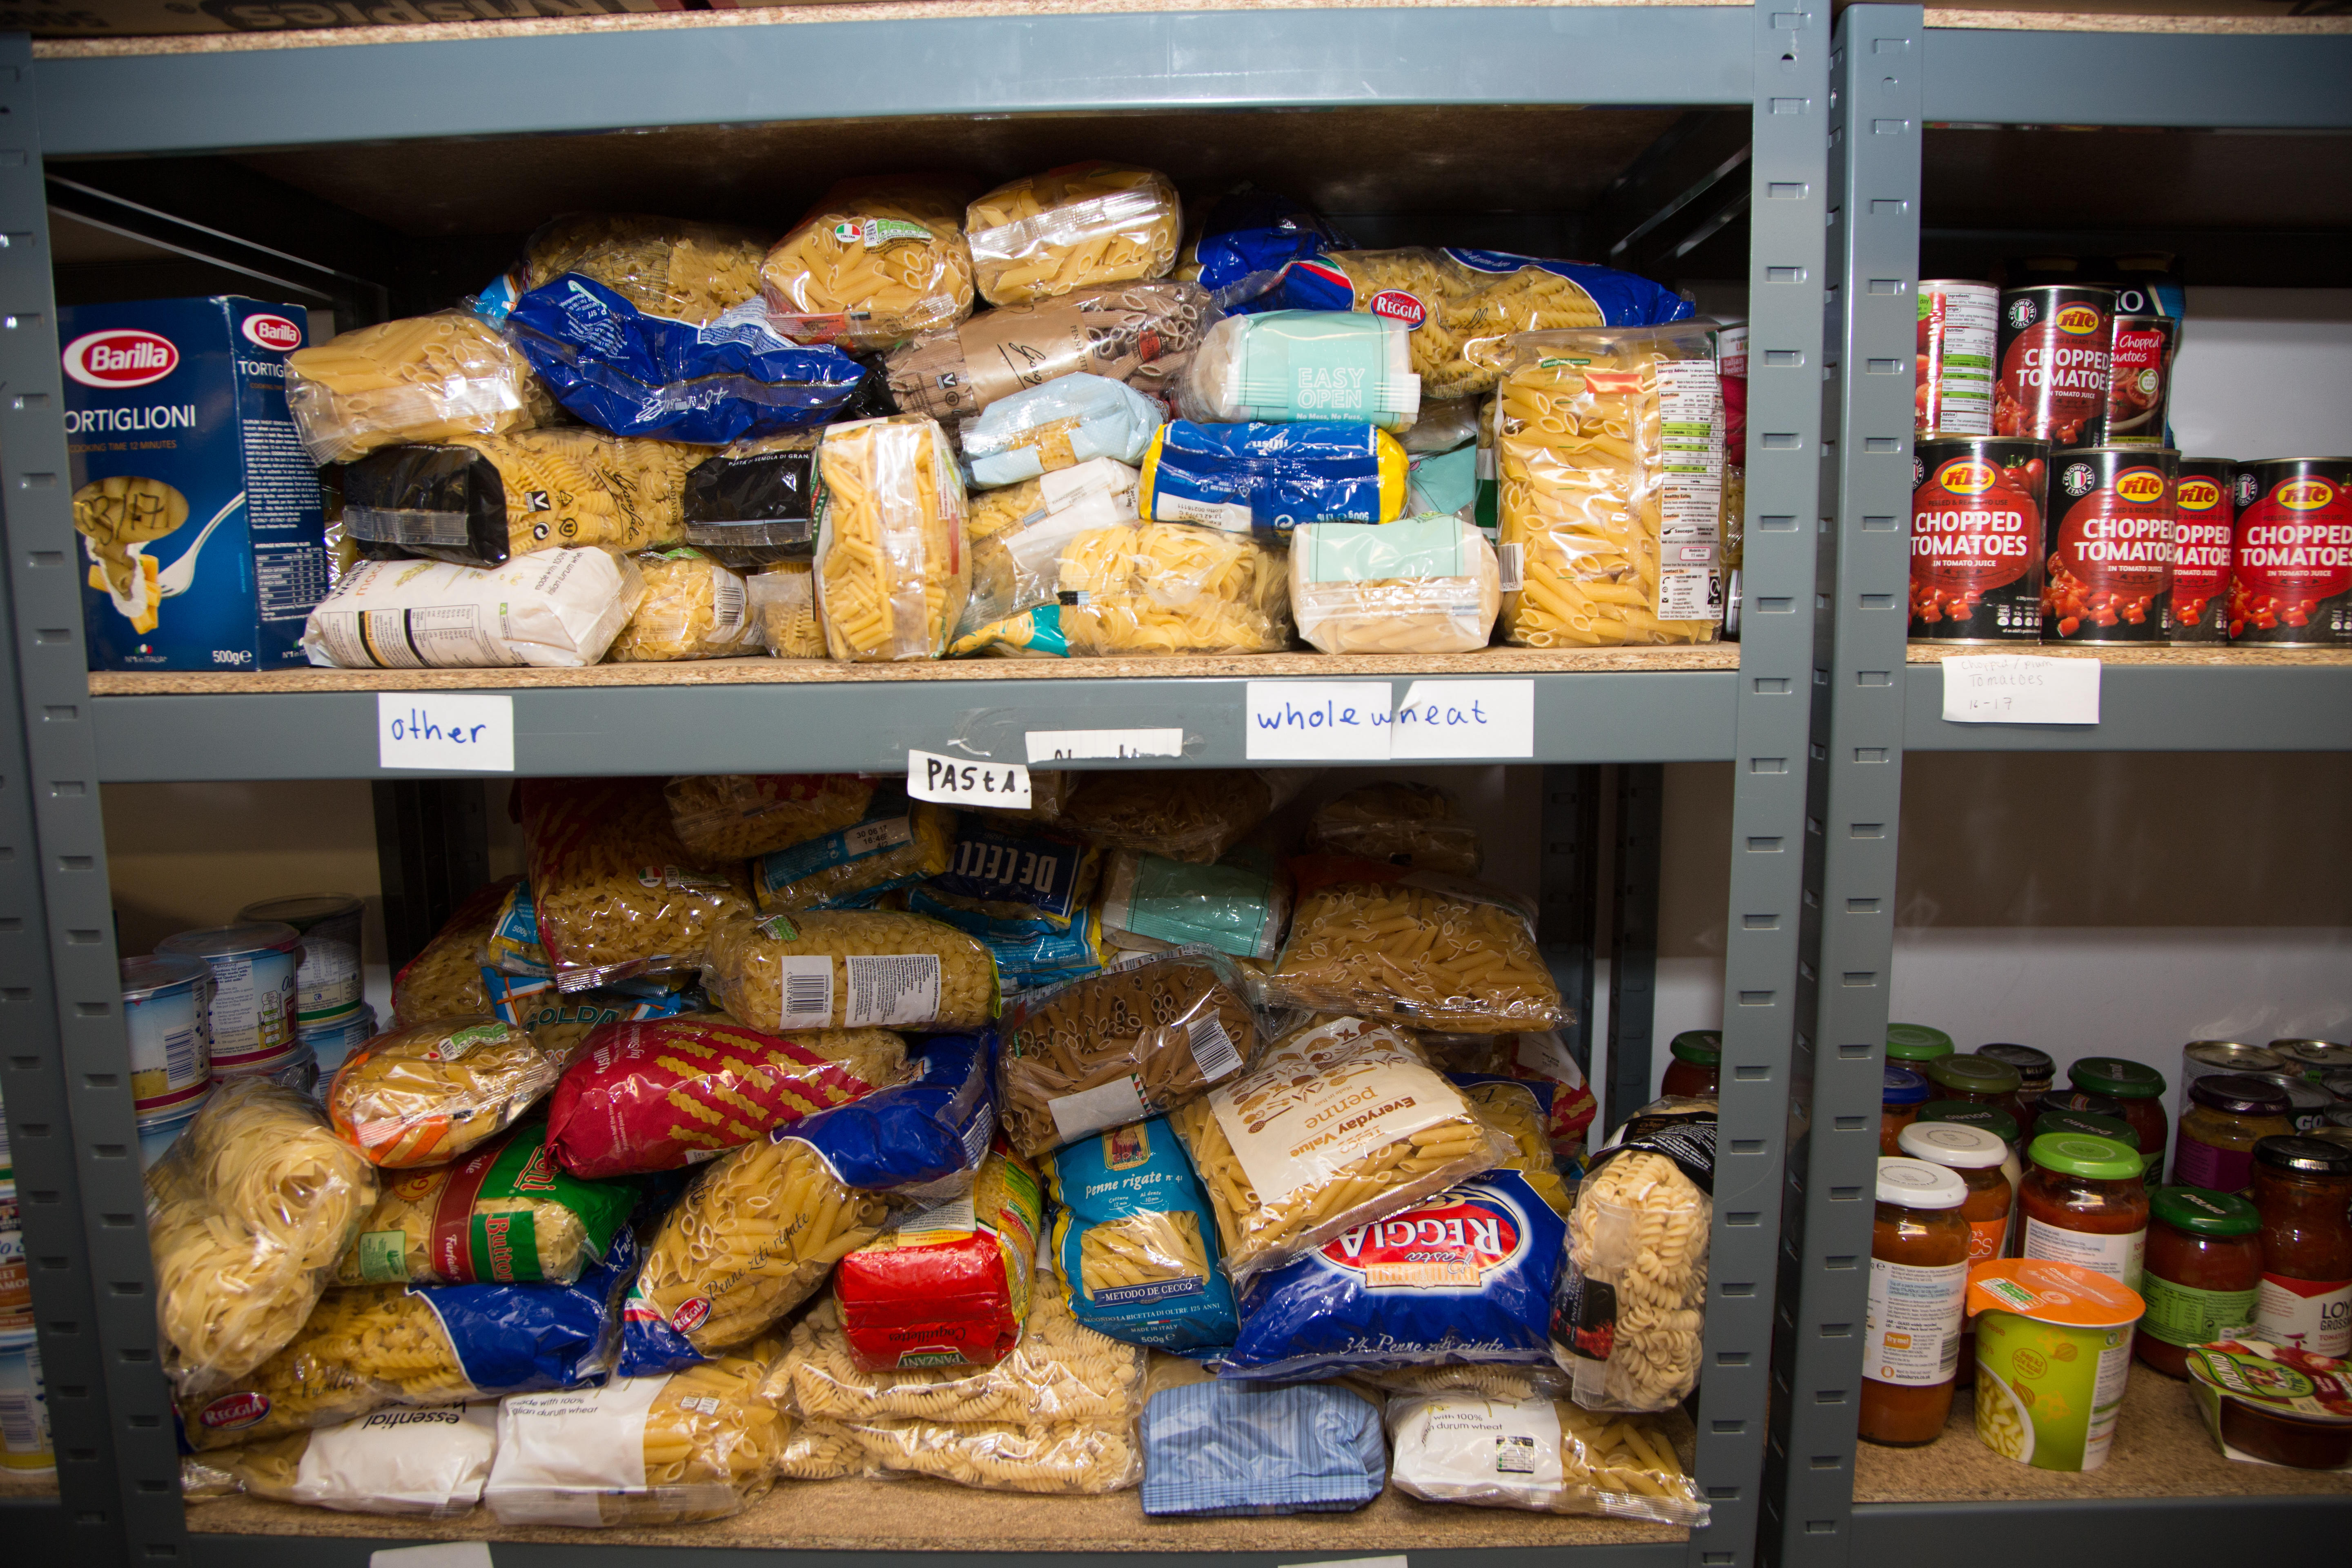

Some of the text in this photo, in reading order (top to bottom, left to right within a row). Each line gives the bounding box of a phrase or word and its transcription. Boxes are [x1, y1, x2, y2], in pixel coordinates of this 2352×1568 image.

[1376, 298, 1421, 321] REGGIA
[2010, 300, 2035, 315] GROWN IN
[2058, 312, 2096, 328] KTC
[258, 322, 298, 342] Barilla
[2120, 334, 2160, 349] Chopped
[90, 341, 168, 371] Barilla
[1070, 325, 1088, 371] PENNE ZITI
[237, 361, 284, 377] TORTIG
[1724, 358, 1744, 366] Italian
[1724, 364, 1744, 374] Peeled
[2025, 348, 2109, 370] CHOPPED
[1298, 367, 1365, 388] EASY
[2016, 369, 2109, 391] TOMATOES
[1298, 389, 1362, 408] OPEN
[65, 404, 196, 434] ORTIGLIONI
[1309, 412, 1329, 421] Mess,
[1343, 413, 1363, 422] Fuss,
[108, 439, 177, 451] TIME 12 MINUTES
[728, 459, 747, 467] PASTA
[755, 455, 779, 463] SEMOLA
[2065, 465, 2093, 481] GROWN IN
[2067, 486, 2087, 494] ITALY
[2120, 477, 2160, 494] KTC
[2178, 486, 2217, 502] KTC
[2279, 487, 2328, 503] KTC
[1915, 511, 2022, 532] CHOPPED
[2082, 518, 2176, 539] CHOPPED
[1911, 535, 2027, 556] TOMATOES
[2175, 526, 2231, 545] OPPED
[2247, 525, 2352, 546] CHOPPED
[534, 550, 568, 590] made 100%
[212, 650, 240, 666] 500g
[1969, 673, 2044, 687] Tomatoes
[1257, 699, 1488, 730] whole wheat
[392, 708, 486, 744] other
[868, 828, 877, 836] 06
[879, 825, 888, 833] 17
[1019, 851, 1058, 893] DE
[594, 1046, 611, 1074] fusilli
[1313, 1084, 1353, 1108] Made Italy
[1304, 1085, 1379, 1129] penne
[1290, 1096, 1416, 1157] Everyday Value
[2062, 1118, 2113, 1136] DOLMIO
[1086, 1176, 1120, 1198] Penne
[1123, 1170, 1162, 1192] rigate
[2181, 1194, 2227, 1215] DOLMIO
[485, 1214, 514, 1282] Buiton
[1335, 1218, 1501, 1258] REGGIA
[704, 1211, 811, 1301] Penne ziti rigate
[1405, 1250, 1474, 1274] Pasta
[1105, 1282, 1193, 1301] METODO DE CECCO
[673, 1299, 709, 1333] REGGIA
[1126, 1311, 1156, 1320] RICETTA
[1165, 1307, 1189, 1315] OLTRE
[2321, 1301, 2352, 1319] LOY
[889, 1328, 966, 1345] Coquillettes
[1377, 1333, 1421, 1353] Penne
[1886, 1335, 1896, 1343] Try
[902, 1353, 964, 1367] PANZANI
[2207, 1353, 2253, 1391] DOLMIO
[205, 1398, 265, 1422] REGGIA
[537, 1405, 598, 1417] durum wheat
[539, 1397, 558, 1406] with
[362, 1412, 461, 1430] essential
